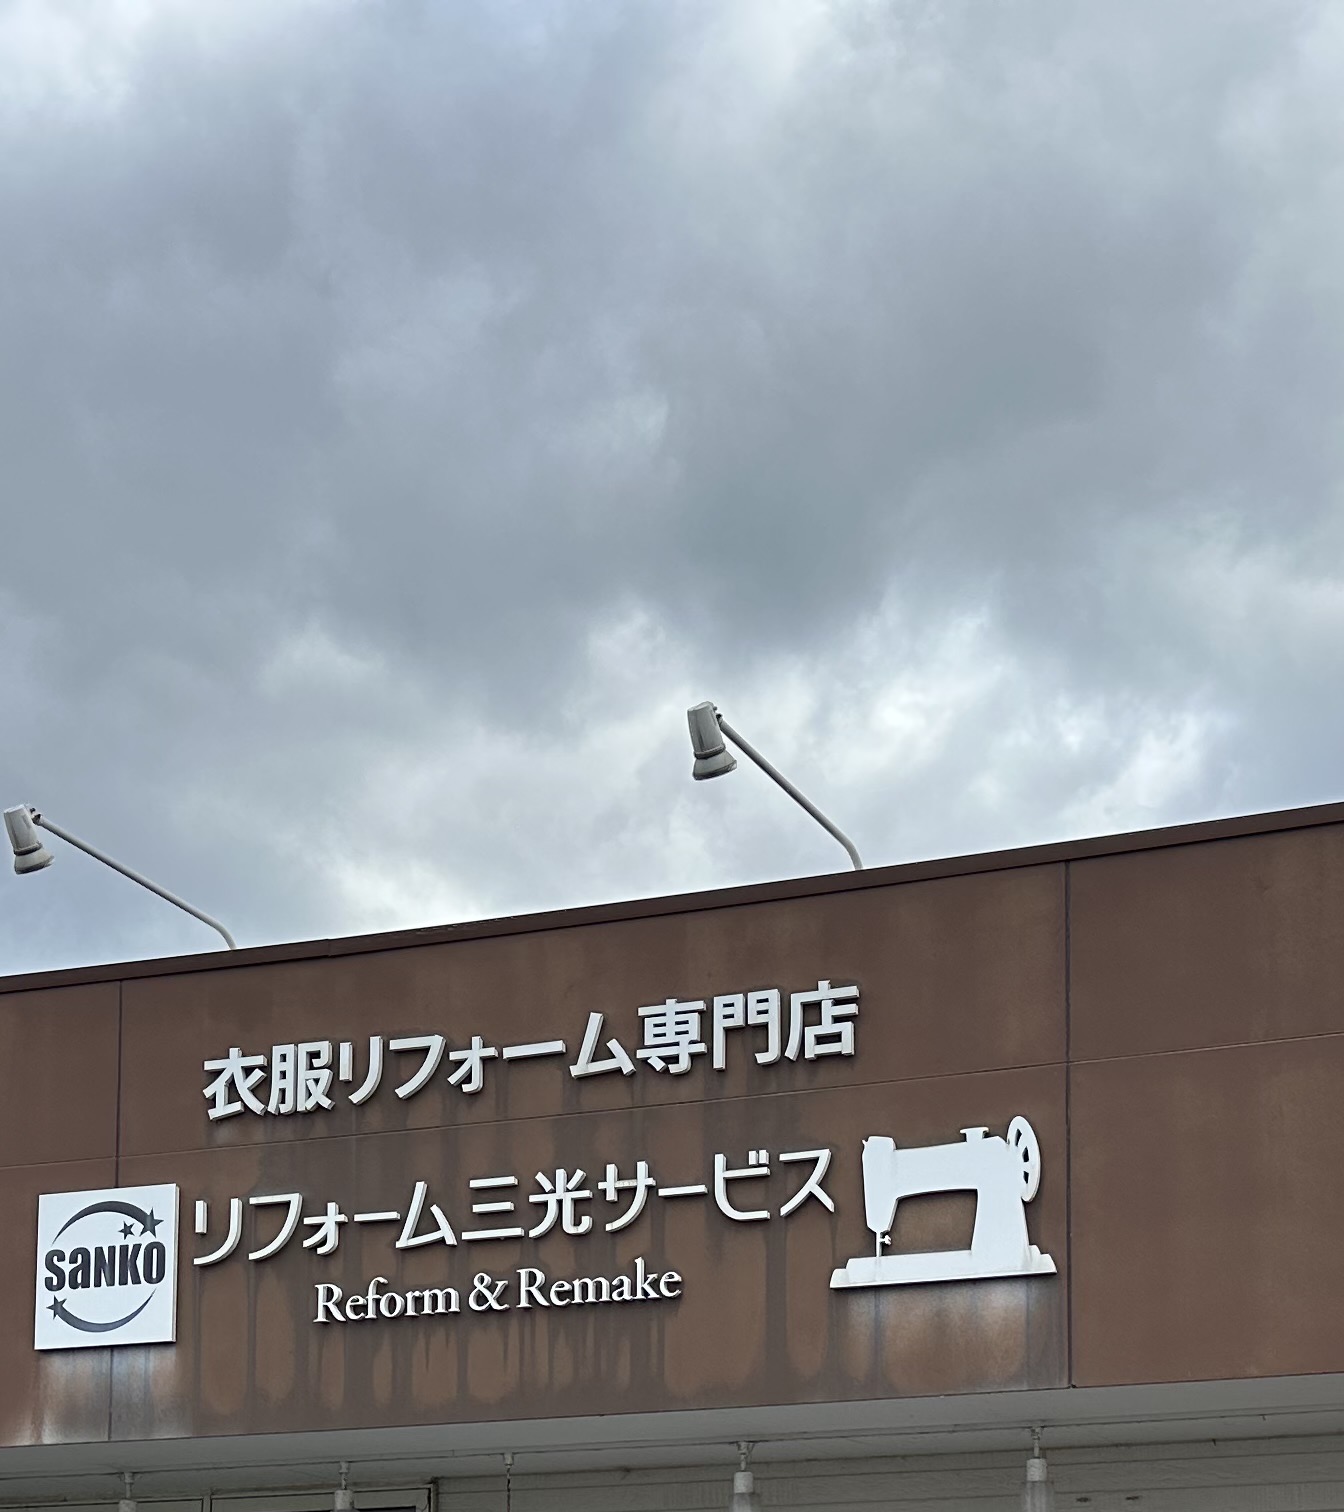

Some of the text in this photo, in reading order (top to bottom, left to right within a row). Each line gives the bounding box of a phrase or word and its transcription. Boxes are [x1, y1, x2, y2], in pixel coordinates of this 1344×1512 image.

[202, 979, 859, 1122] 衣服リフォーム専門店
[190, 1145, 836, 1267] リフォーム三光サービス
[313, 1258, 683, 1324] Reform & Remake
